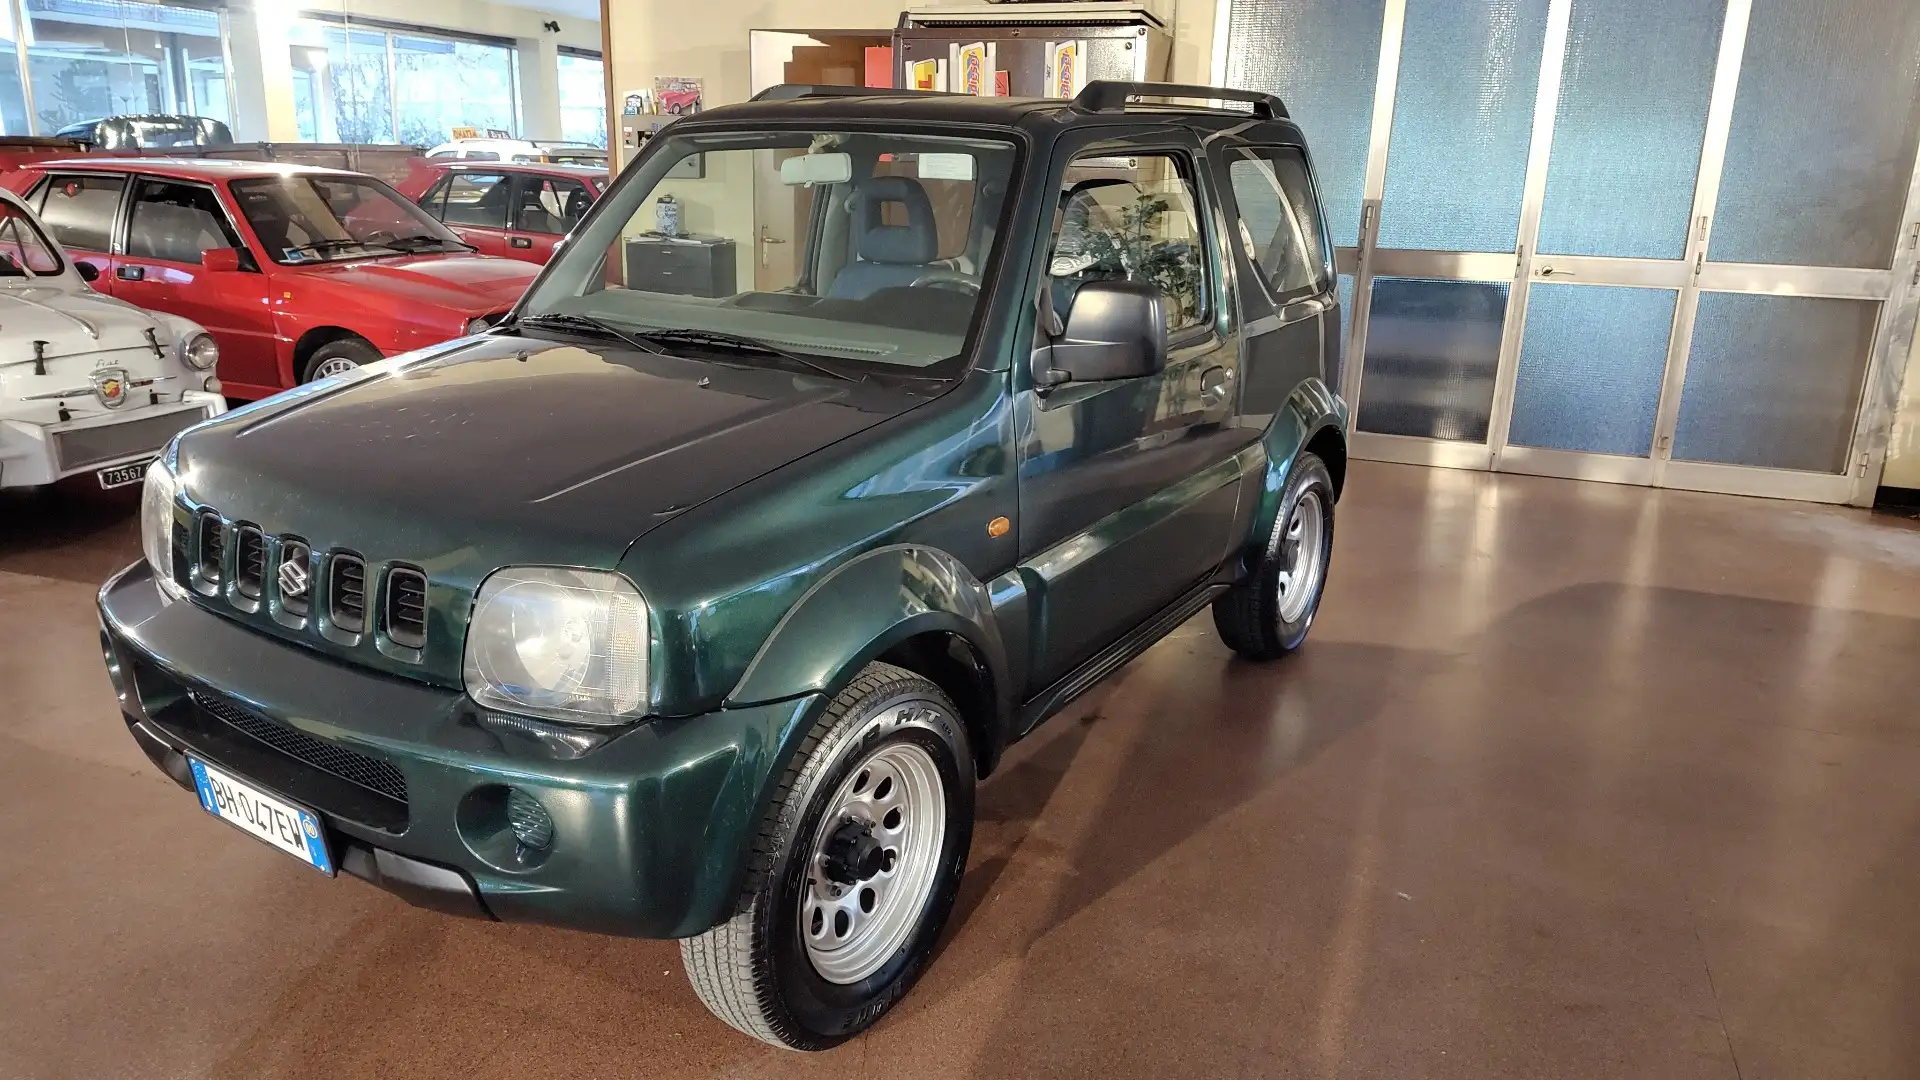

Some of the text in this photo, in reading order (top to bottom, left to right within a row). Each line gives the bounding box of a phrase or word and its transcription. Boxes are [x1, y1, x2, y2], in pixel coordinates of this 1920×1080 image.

[107, 466, 142, 484] 73567
[209, 775, 305, 851] BH 047EW
